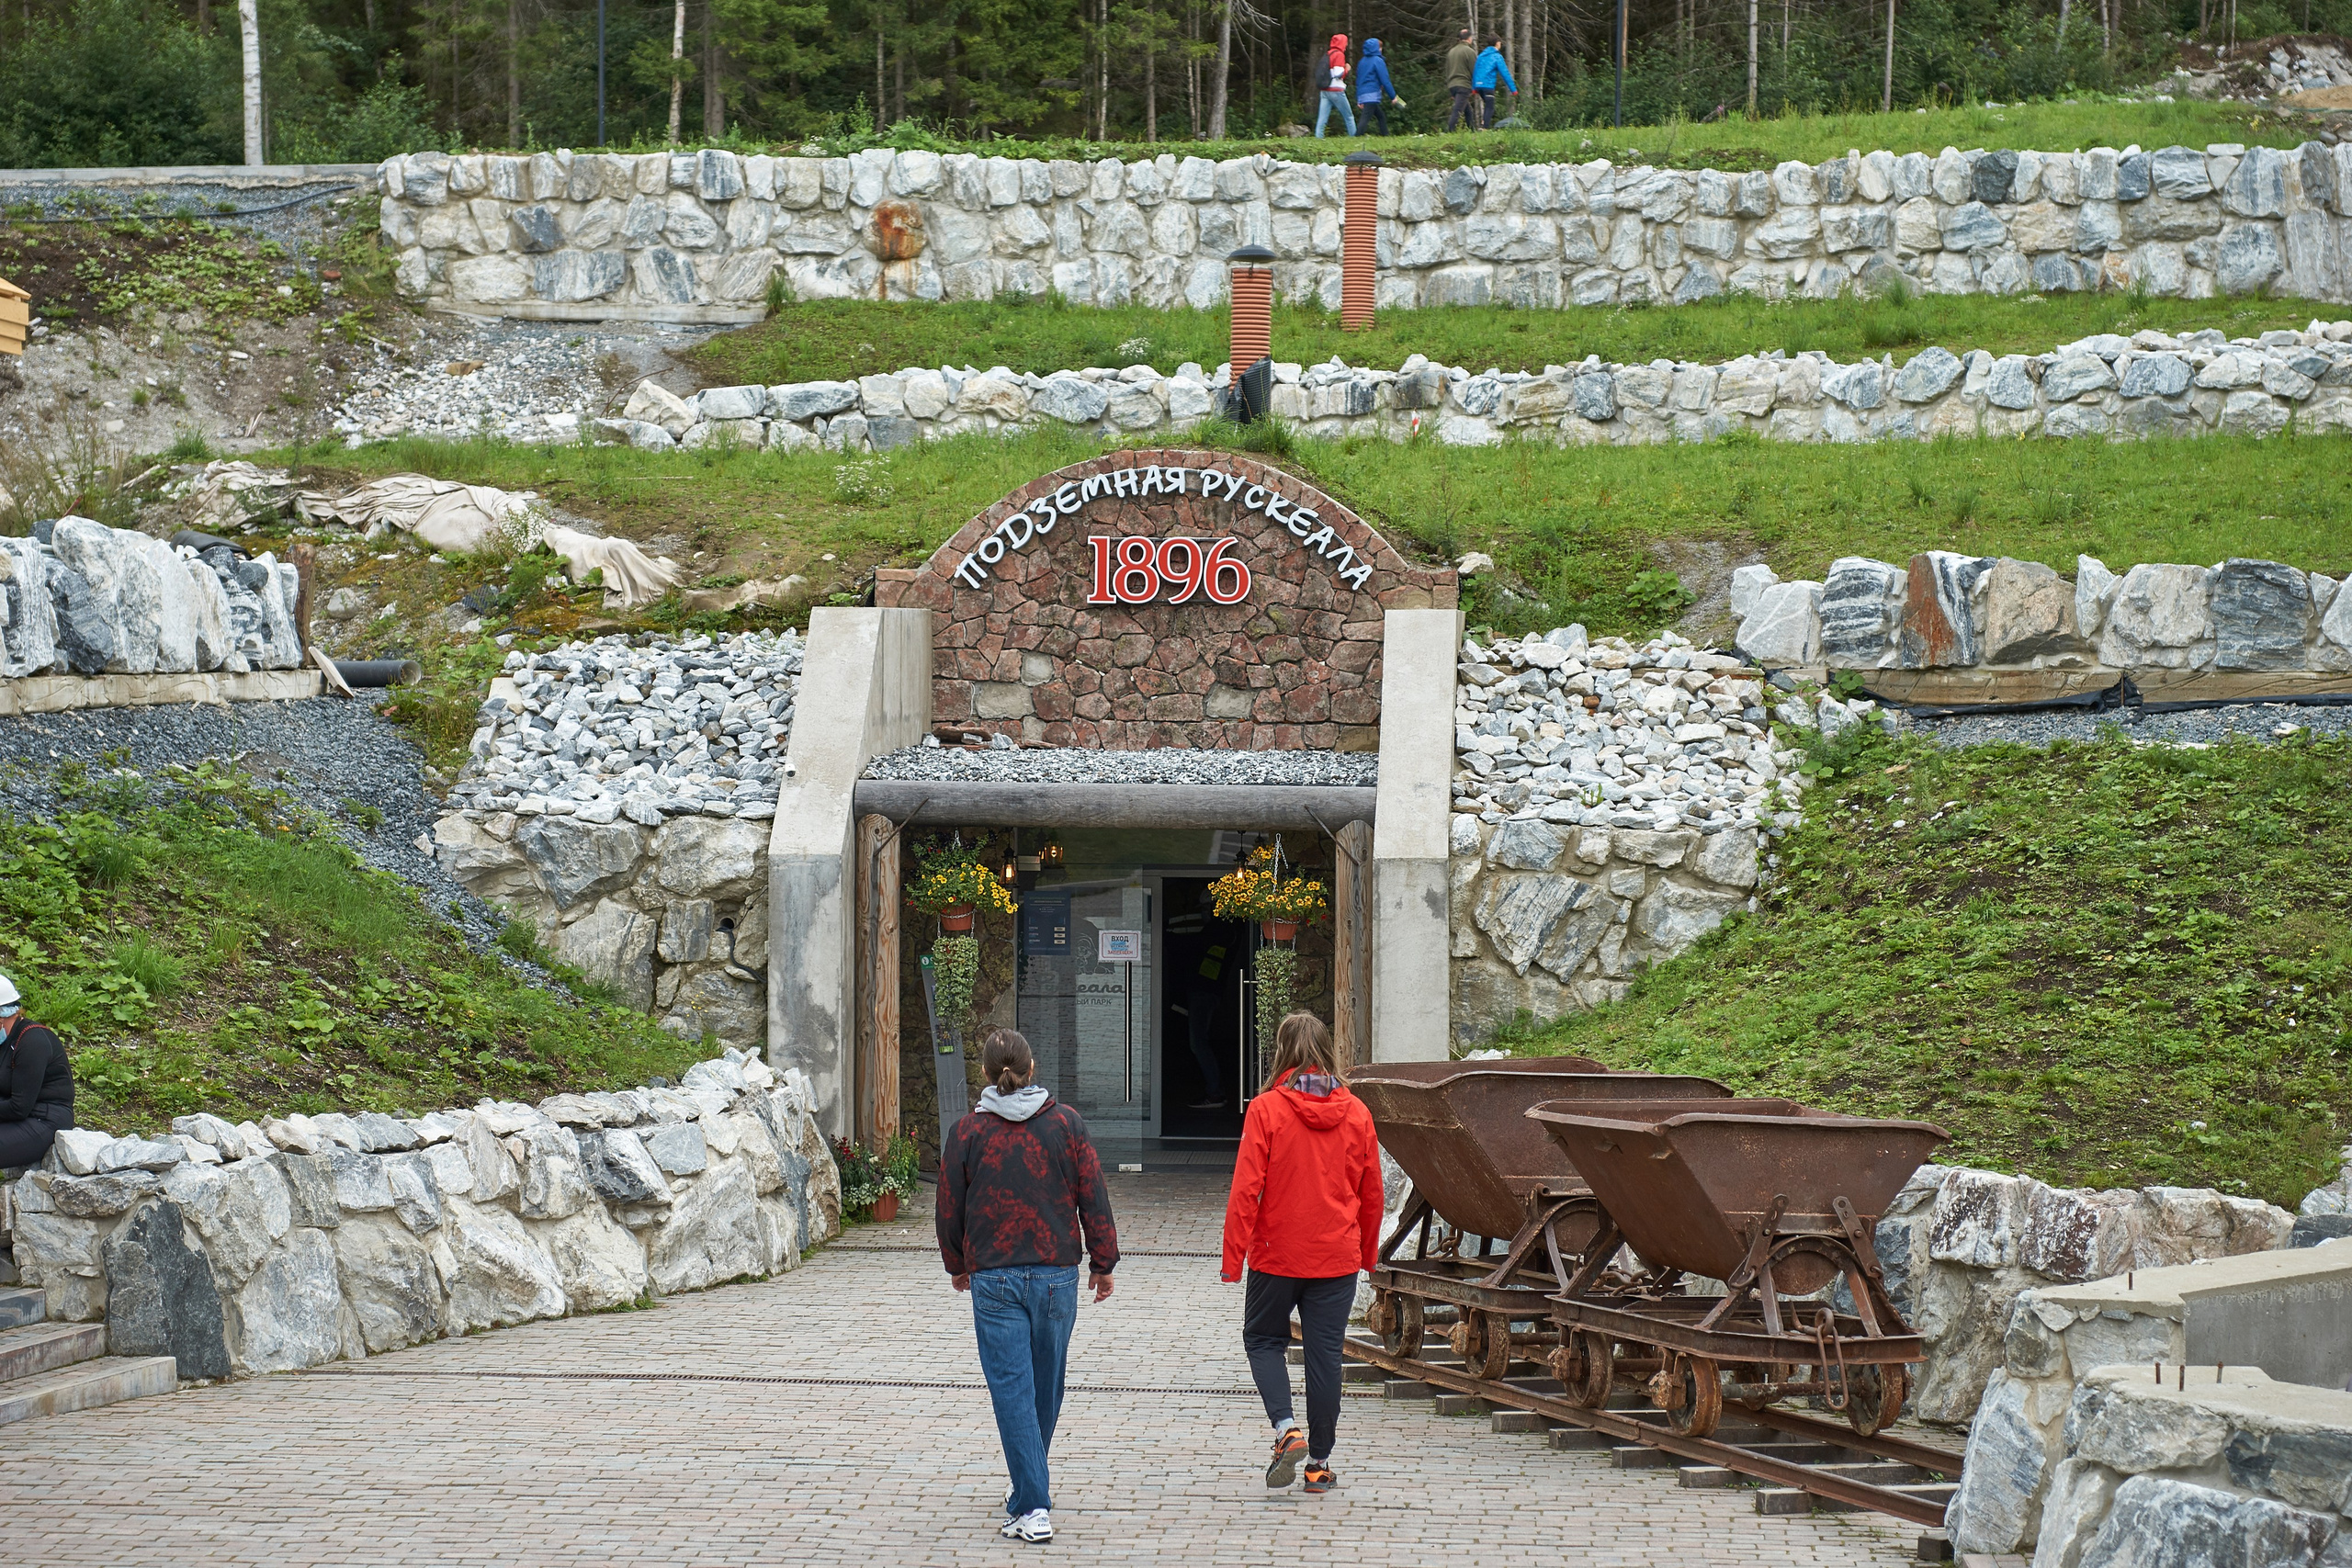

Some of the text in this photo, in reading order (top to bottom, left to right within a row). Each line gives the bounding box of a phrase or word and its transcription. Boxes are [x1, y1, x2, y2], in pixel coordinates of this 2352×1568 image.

[954, 464, 1374, 591] ПОДЗЕМНАЯ РУСКЕАЛА
[1086, 536, 1251, 604] 1896
